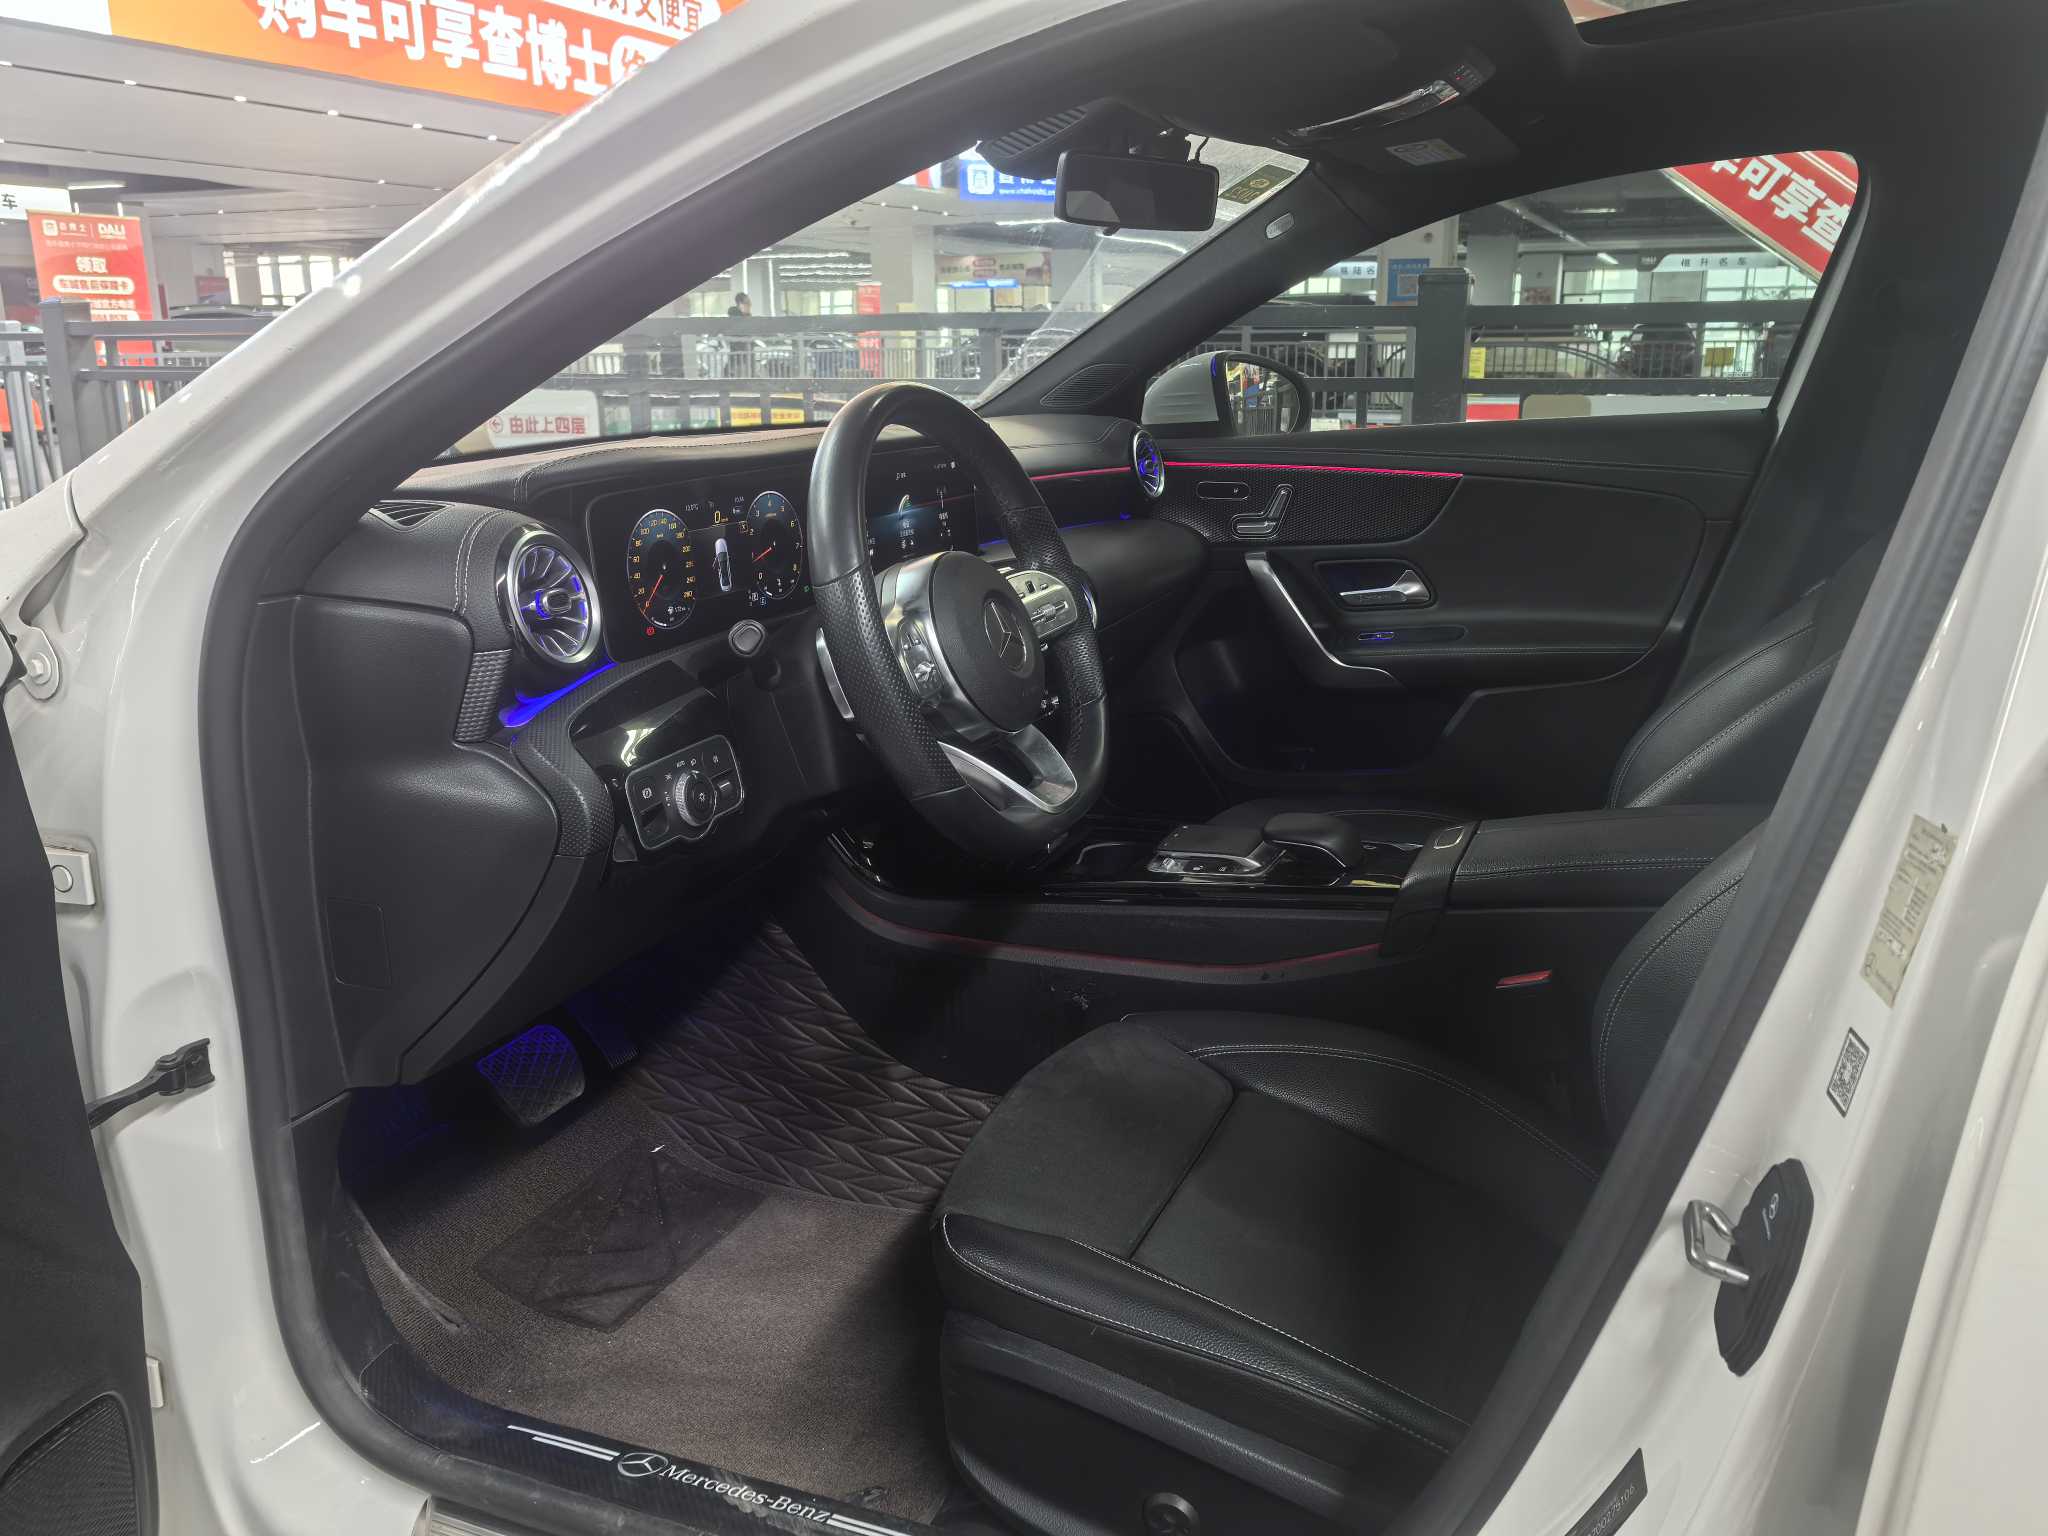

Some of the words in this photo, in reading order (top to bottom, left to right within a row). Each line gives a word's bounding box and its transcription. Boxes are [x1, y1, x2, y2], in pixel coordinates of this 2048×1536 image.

[75, 256, 108, 273] 领取
[510, 416, 586, 435] 由此上四层
[659, 1464, 837, 1523] Mercedes-Benz
